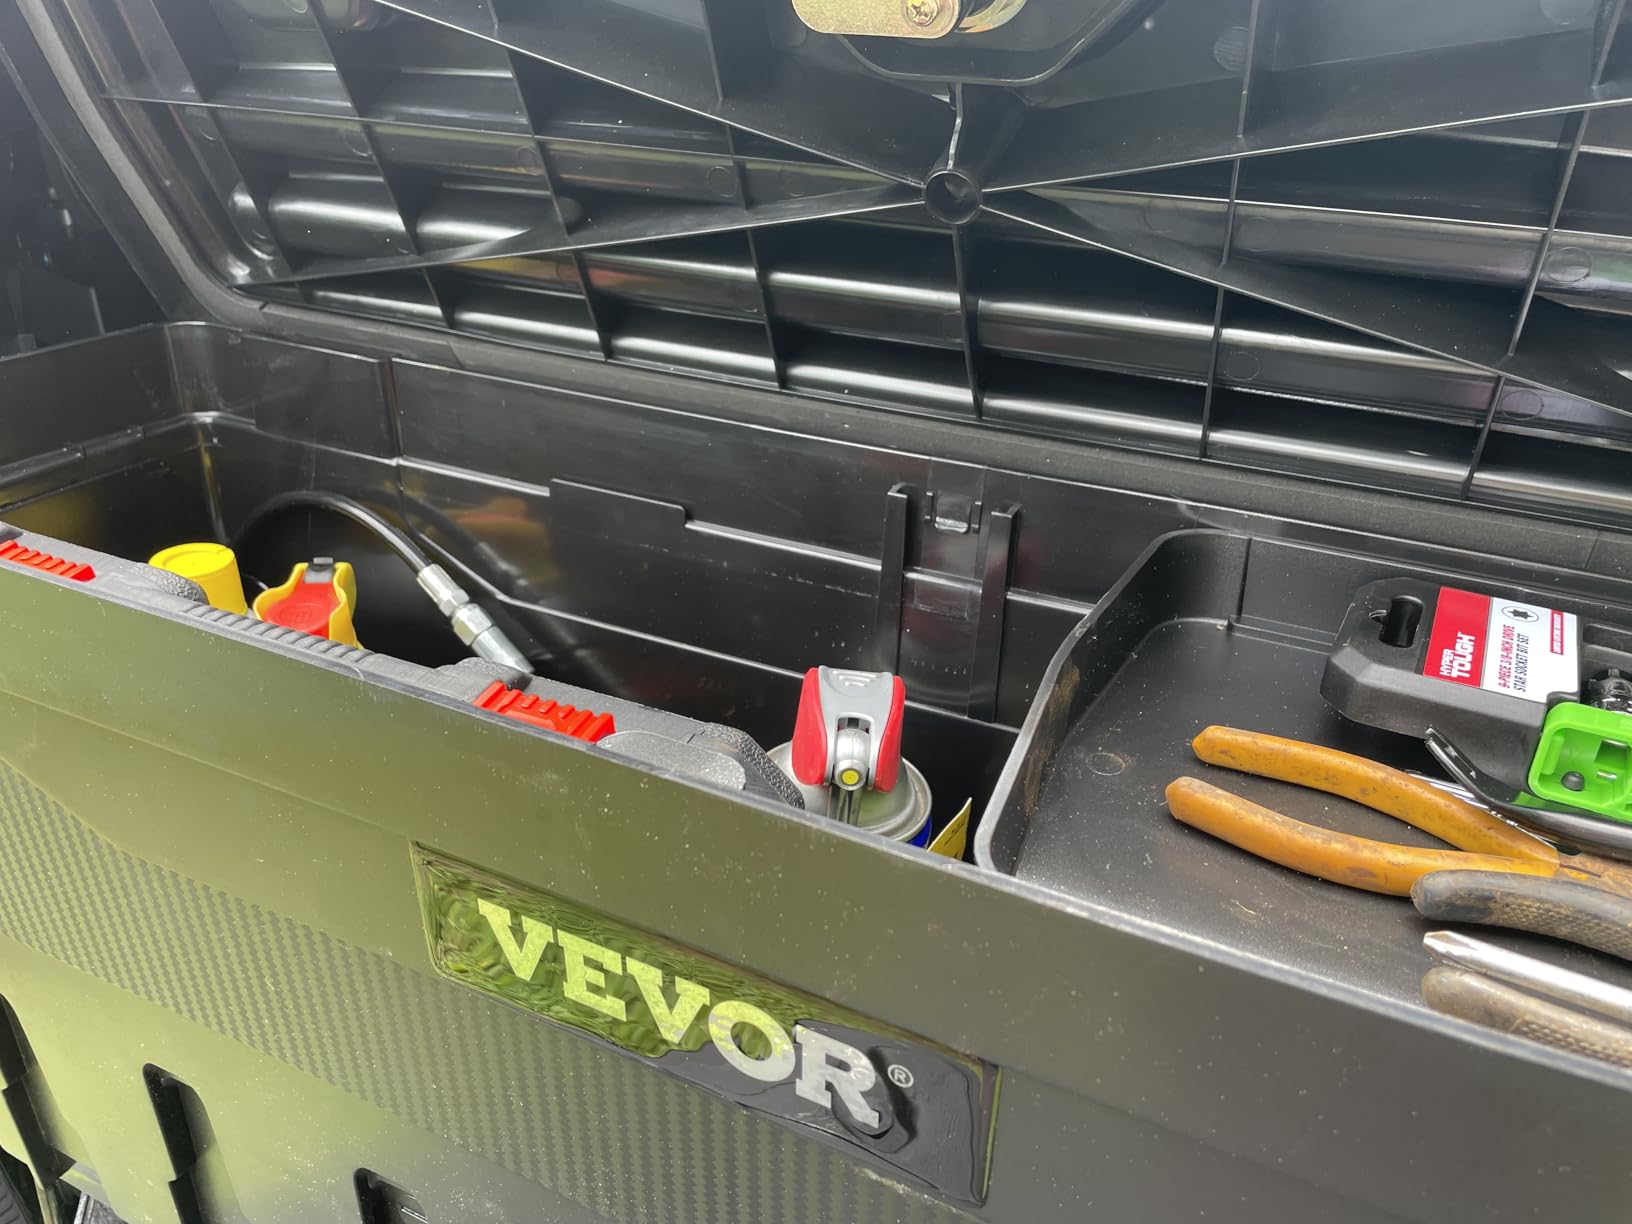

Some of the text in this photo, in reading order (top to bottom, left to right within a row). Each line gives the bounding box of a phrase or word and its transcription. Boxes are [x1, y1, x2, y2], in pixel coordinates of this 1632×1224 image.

[1502, 624, 1515, 641] DRIVE
[1439, 649, 1455, 677] HYPER
[1450, 633, 1475, 678] TOUGH
[1514, 633, 1528, 692] STAR SOCKET BIT SET
[1498, 665, 1511, 688] 9-PIECE
[477, 898, 880, 1129] VEVOR
